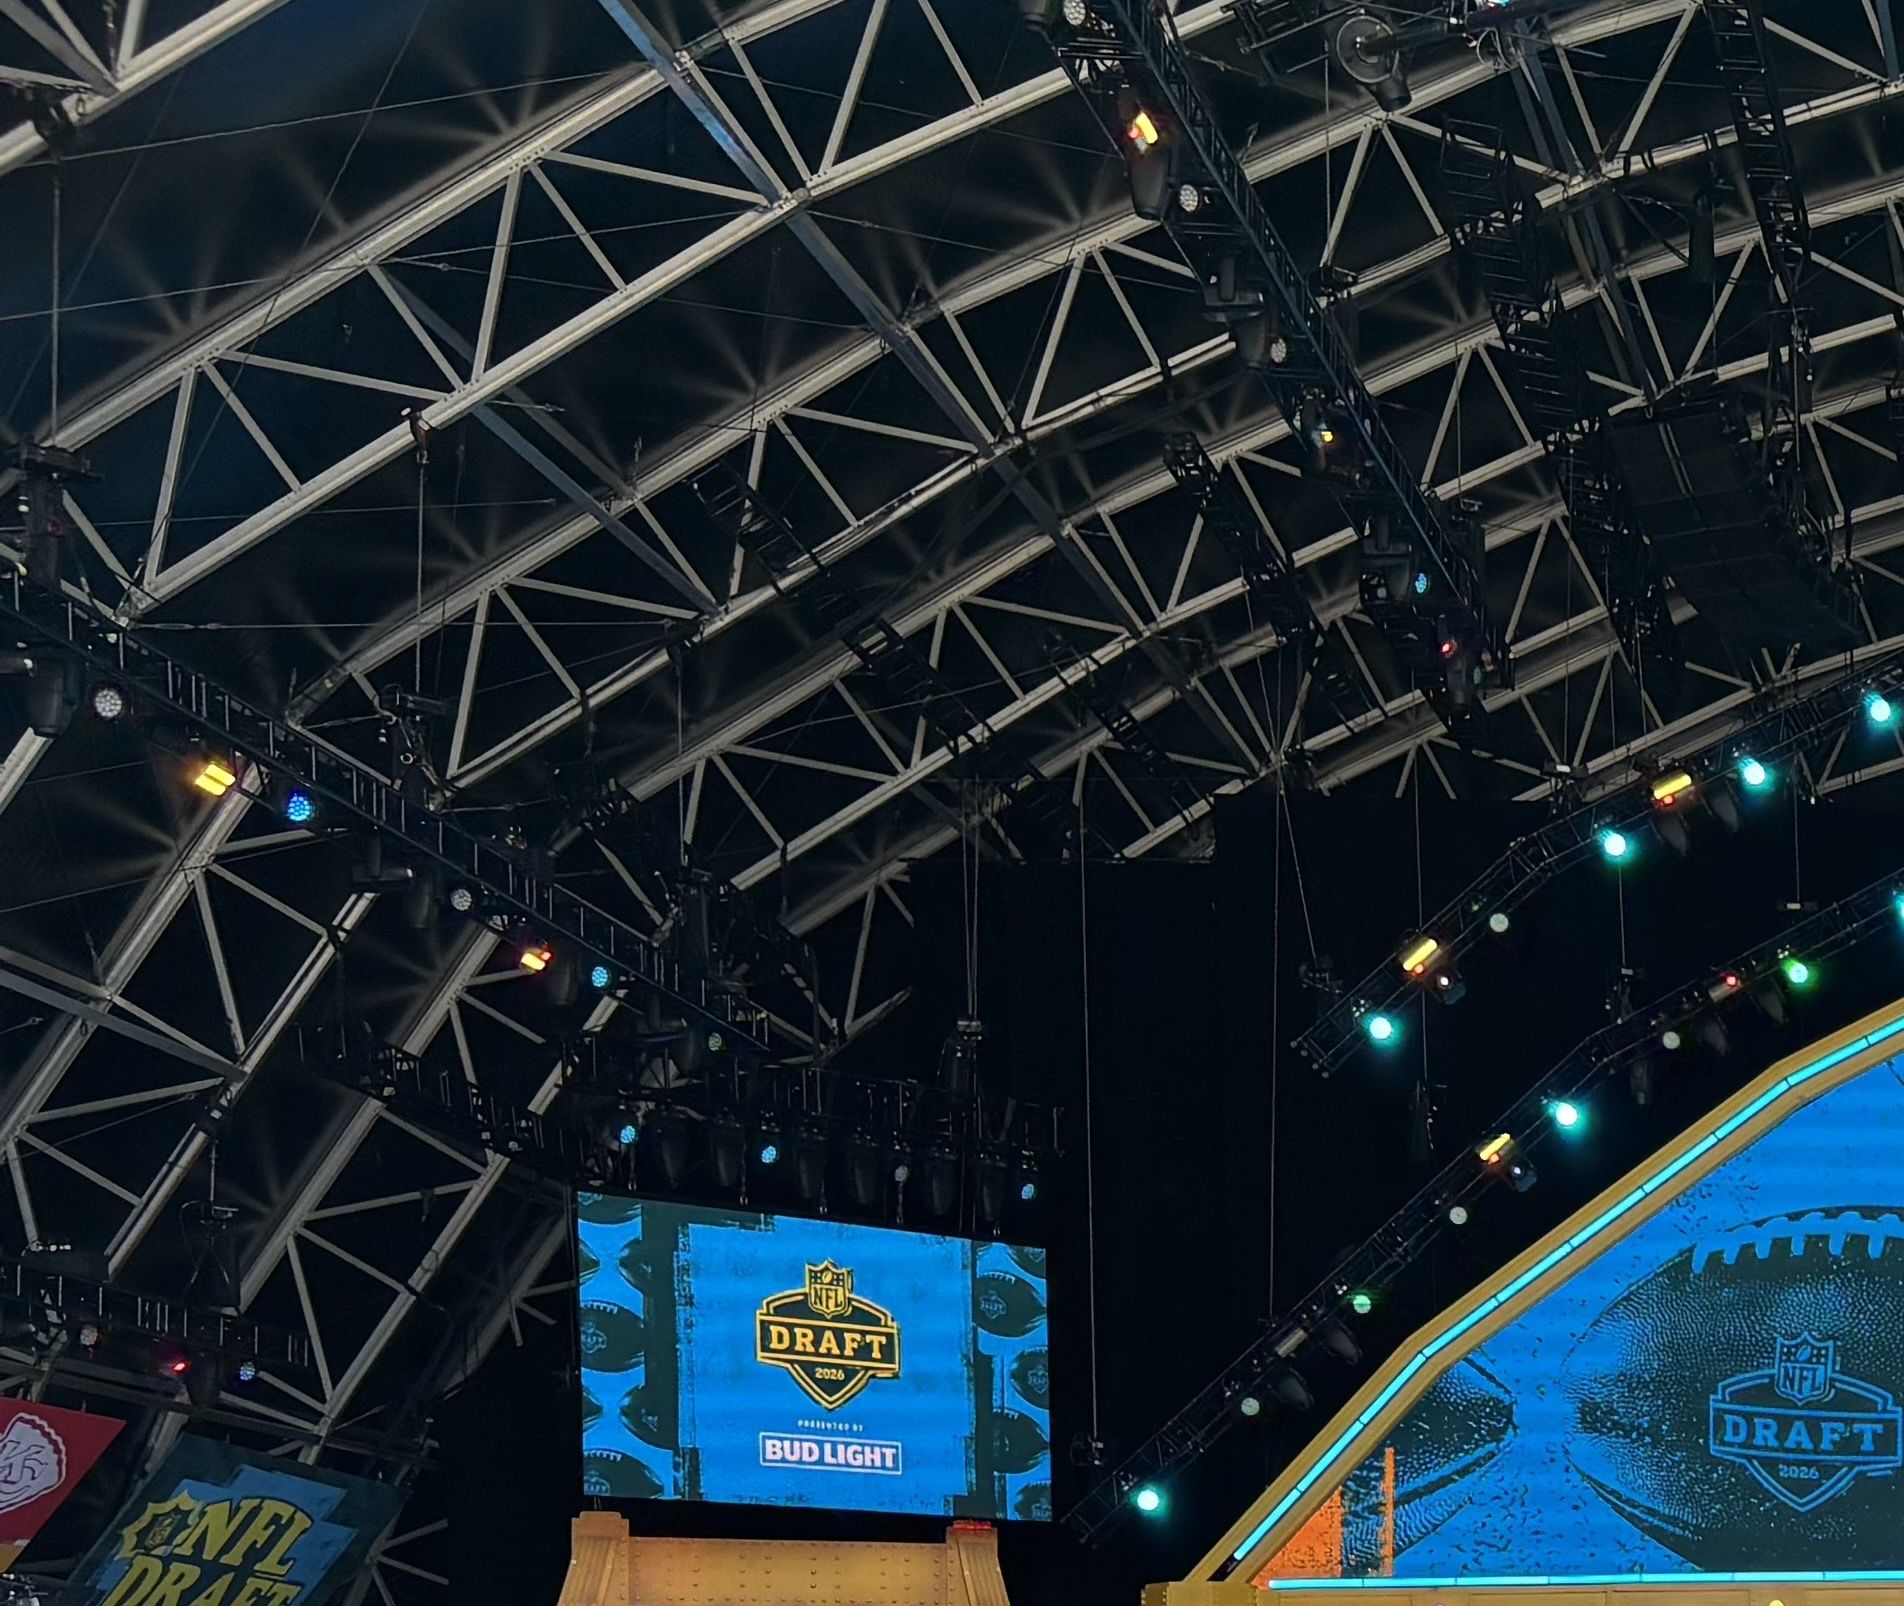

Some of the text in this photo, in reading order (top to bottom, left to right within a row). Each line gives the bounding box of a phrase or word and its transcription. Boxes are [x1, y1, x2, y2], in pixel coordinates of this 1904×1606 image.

[812, 1285, 845, 1313] NFL
[768, 1324, 888, 1360] DRAFT
[815, 1367, 845, 1381] 2026
[1780, 1364, 1826, 1397] NFL
[1723, 1414, 1885, 1452] DRAFT
[765, 1439, 897, 1468] BUD LIGHT
[1779, 1464, 1820, 1480] 2026
[177, 1498, 312, 1577] NFL
